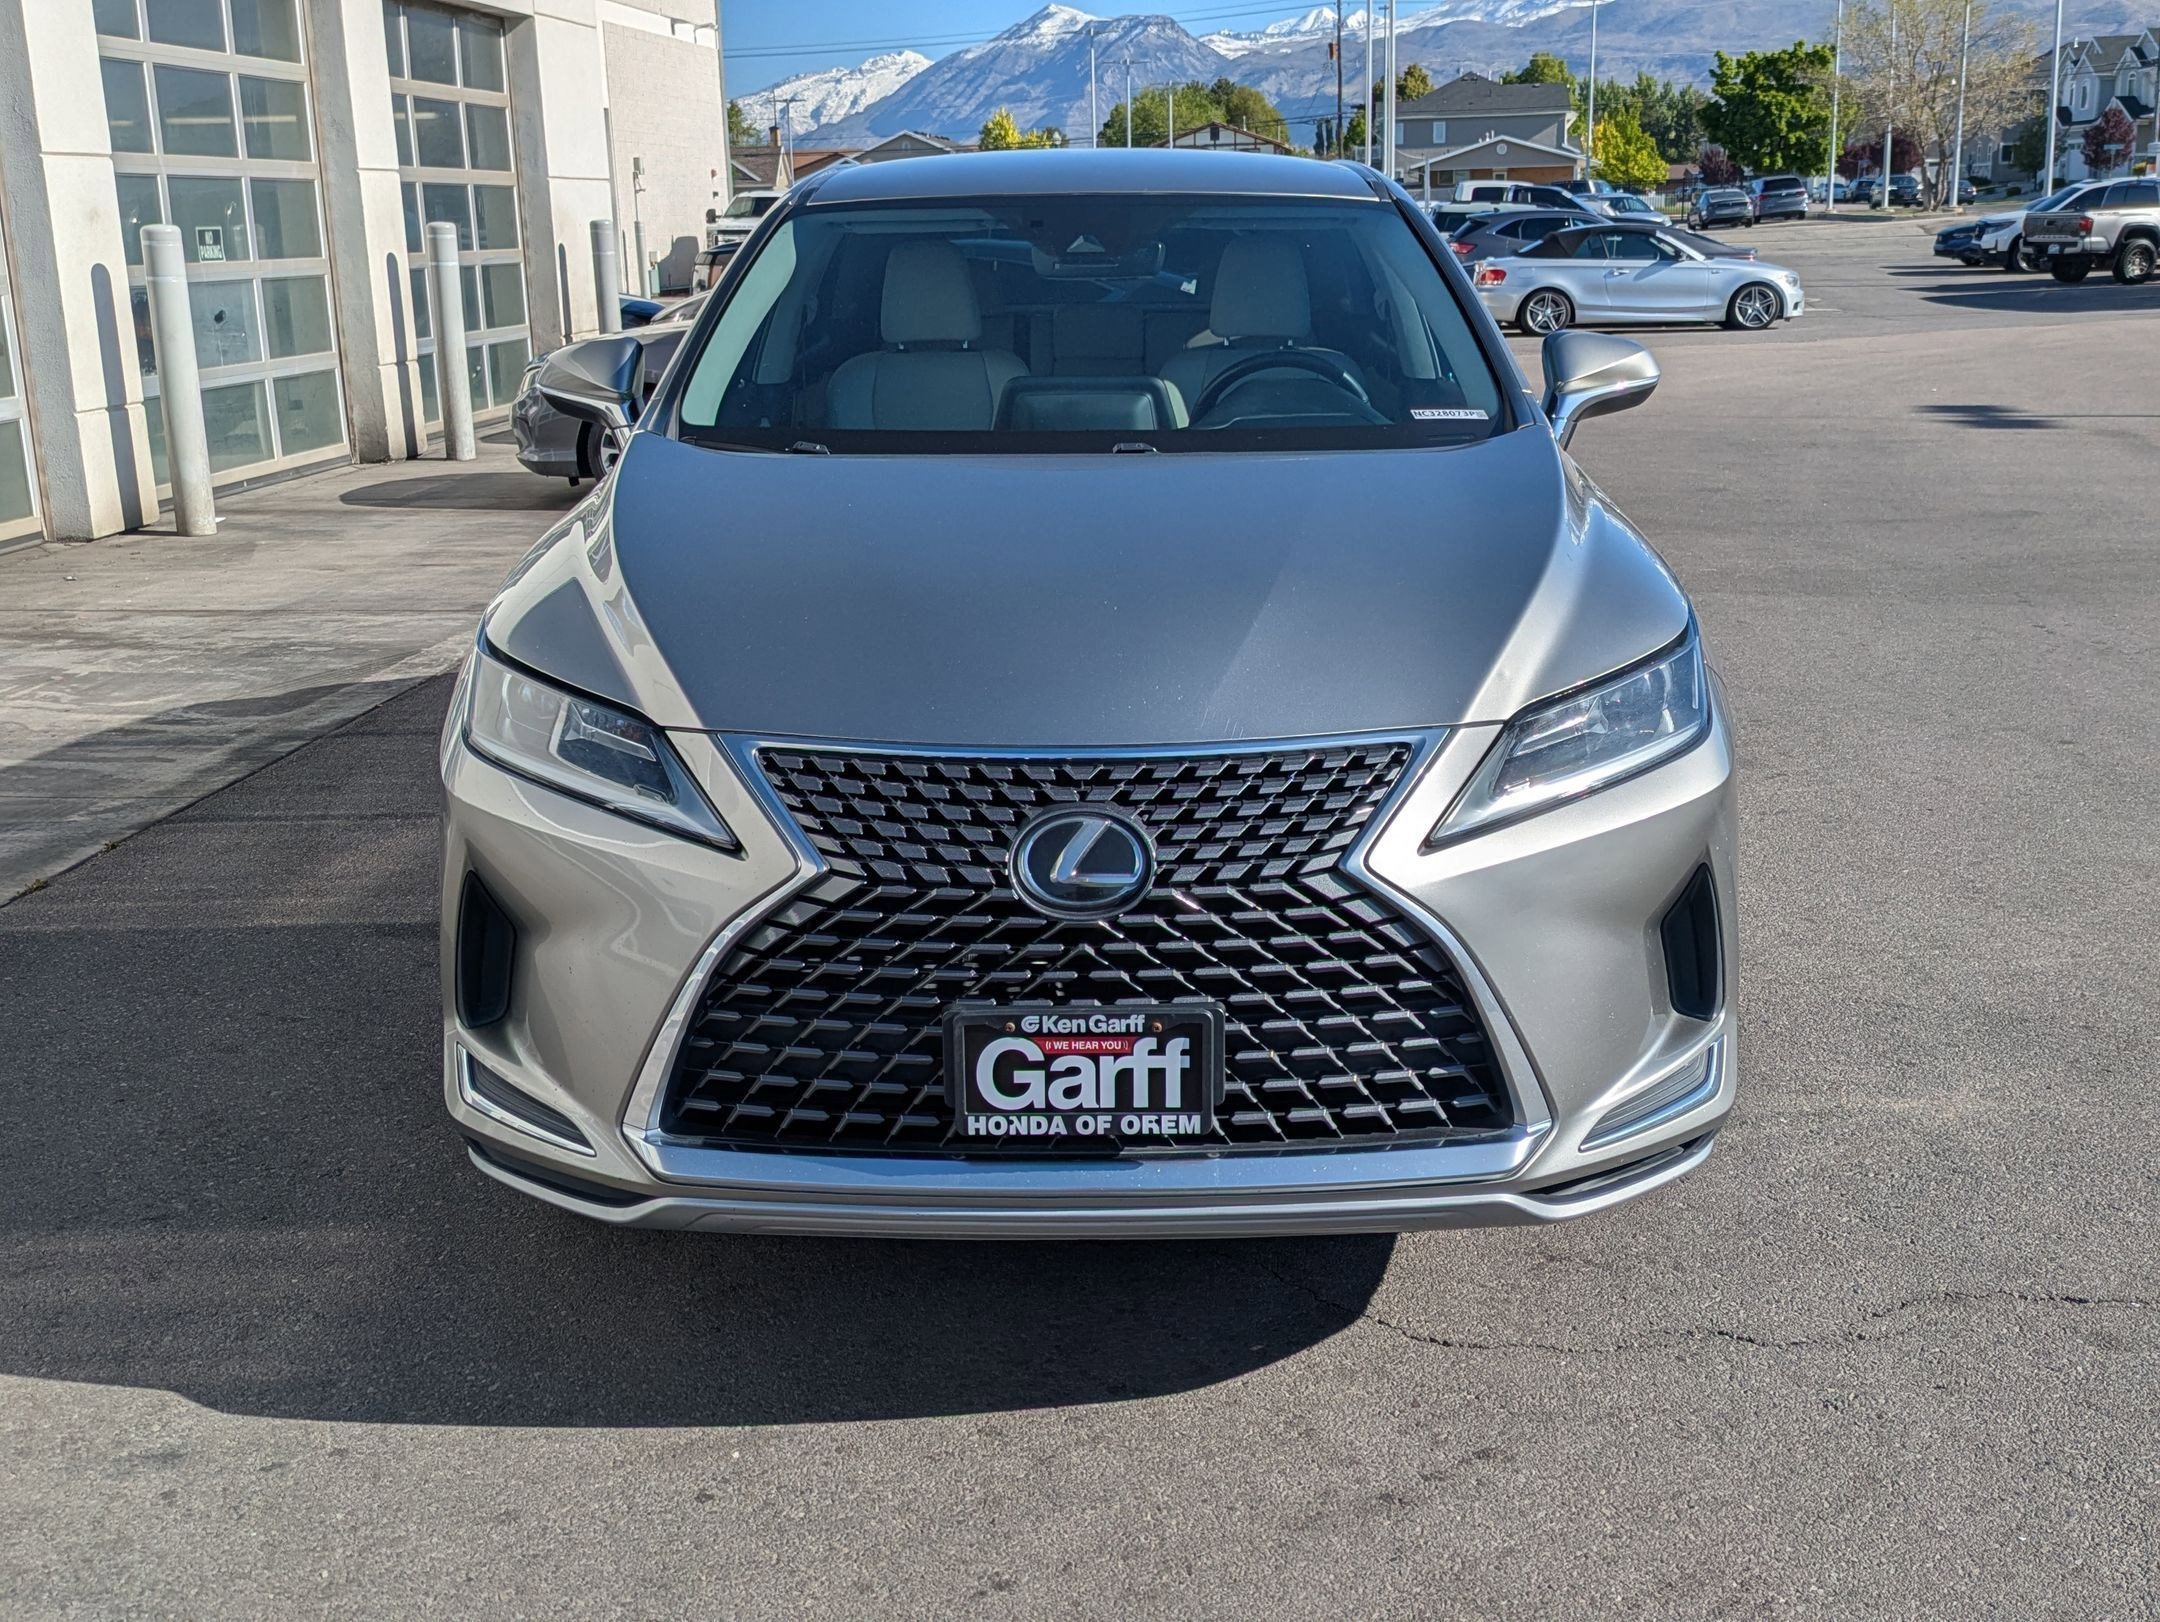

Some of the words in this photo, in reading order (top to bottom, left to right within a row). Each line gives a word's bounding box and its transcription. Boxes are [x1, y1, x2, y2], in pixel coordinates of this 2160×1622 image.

[1042, 1015, 1086, 1033] Ken
[1089, 1015, 1145, 1033] Garff
[1053, 1041, 1070, 1050] WE
[1071, 1041, 1099, 1050] HEAR
[1101, 1041, 1122, 1050] YOU
[976, 1037, 1190, 1111] Garff
[967, 1115, 1068, 1136] HONDA
[1076, 1115, 1112, 1136] OF
[1120, 1115, 1201, 1135] OREM
